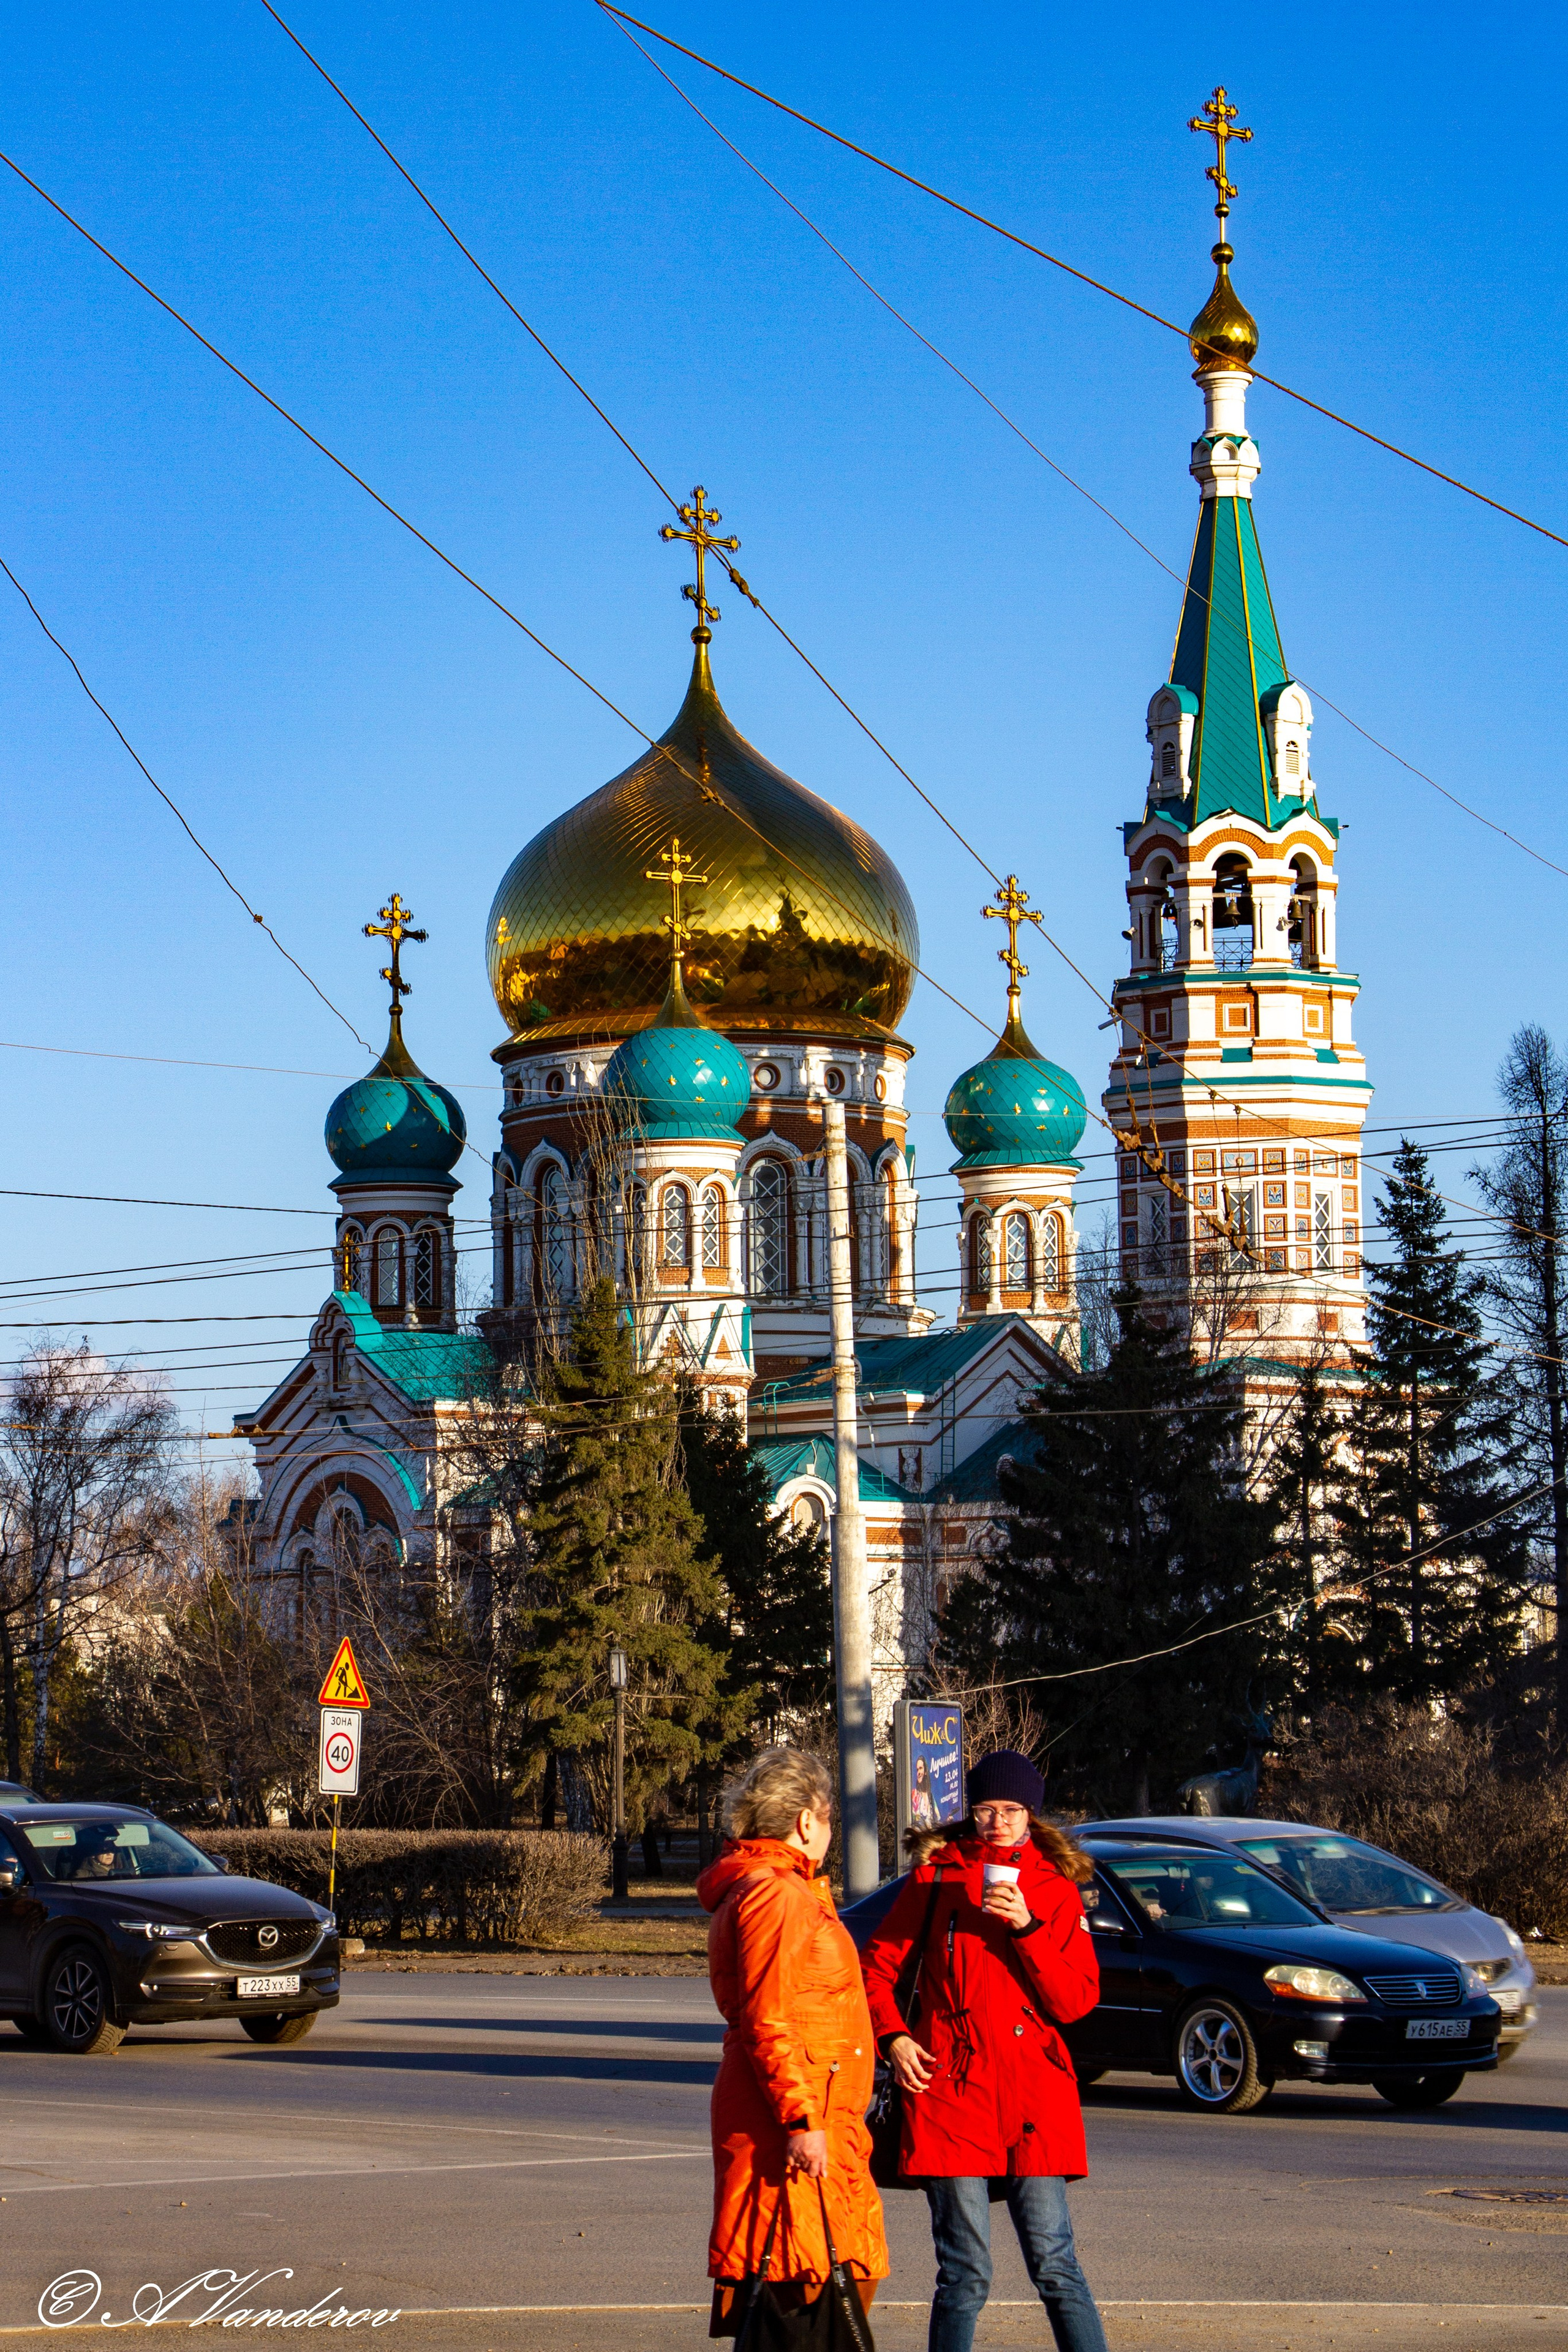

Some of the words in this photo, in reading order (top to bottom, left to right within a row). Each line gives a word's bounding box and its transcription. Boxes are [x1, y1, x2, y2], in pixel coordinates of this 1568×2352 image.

[331, 1716, 352, 1726] ЗОНА
[331, 1745, 349, 1762] 40
[930, 1744, 959, 1778] Лучшее!
[944, 1768, 959, 1783] 23.04
[287, 1977, 296, 1987] 55
[1455, 2021, 1468, 2032] 55
